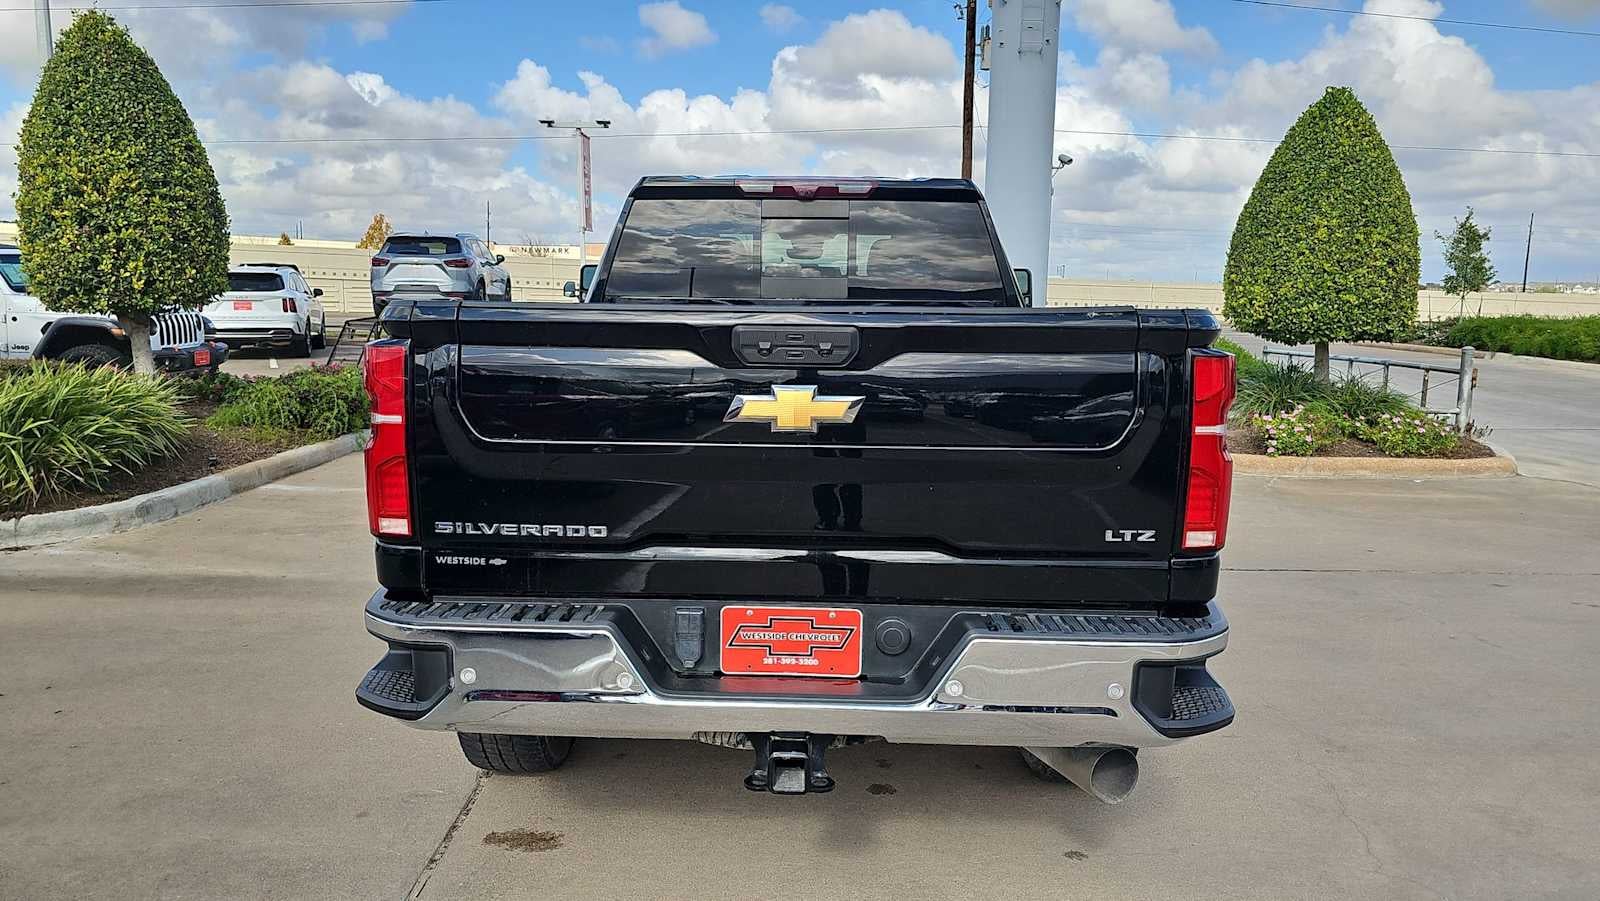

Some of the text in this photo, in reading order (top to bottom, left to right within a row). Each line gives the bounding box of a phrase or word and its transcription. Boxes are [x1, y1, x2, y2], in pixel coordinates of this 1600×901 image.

[434, 521, 608, 538] SILVERADO
[1105, 529, 1156, 542] LTZ
[435, 556, 486, 566] WESTSIDE
[741, 631, 841, 642] WESTSIDE CHEVROLET
[762, 657, 820, 667] 281-392-3200
